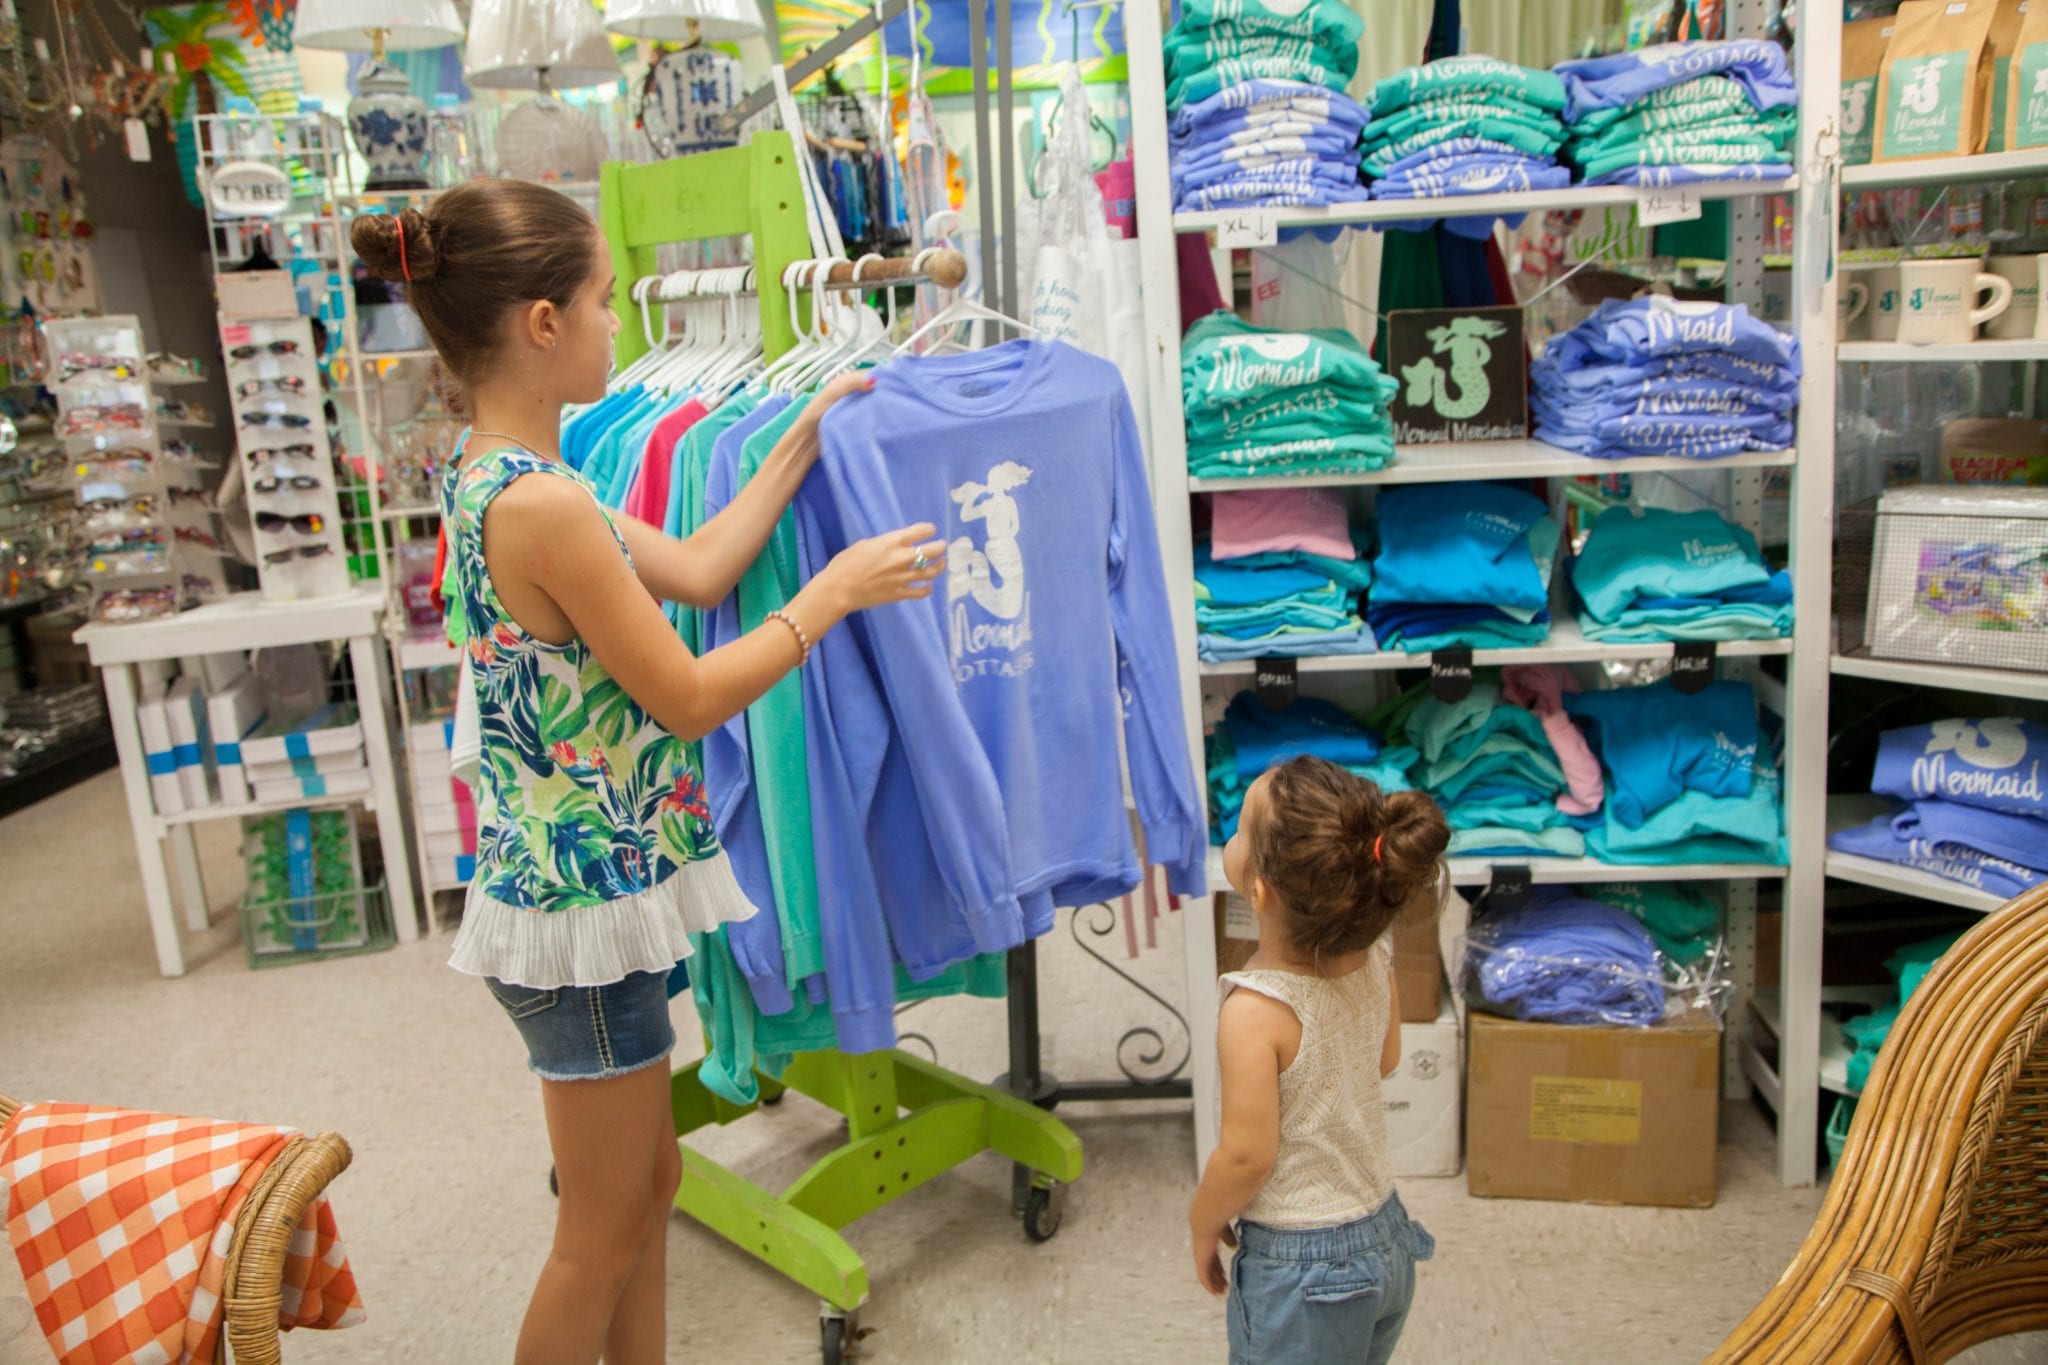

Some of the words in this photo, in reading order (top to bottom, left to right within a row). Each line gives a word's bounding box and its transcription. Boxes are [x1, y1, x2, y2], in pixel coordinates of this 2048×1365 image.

[1225, 217, 1250, 234] XL
[1206, 345, 1323, 393] Mermaid
[1911, 753, 2044, 801] Mermaid
